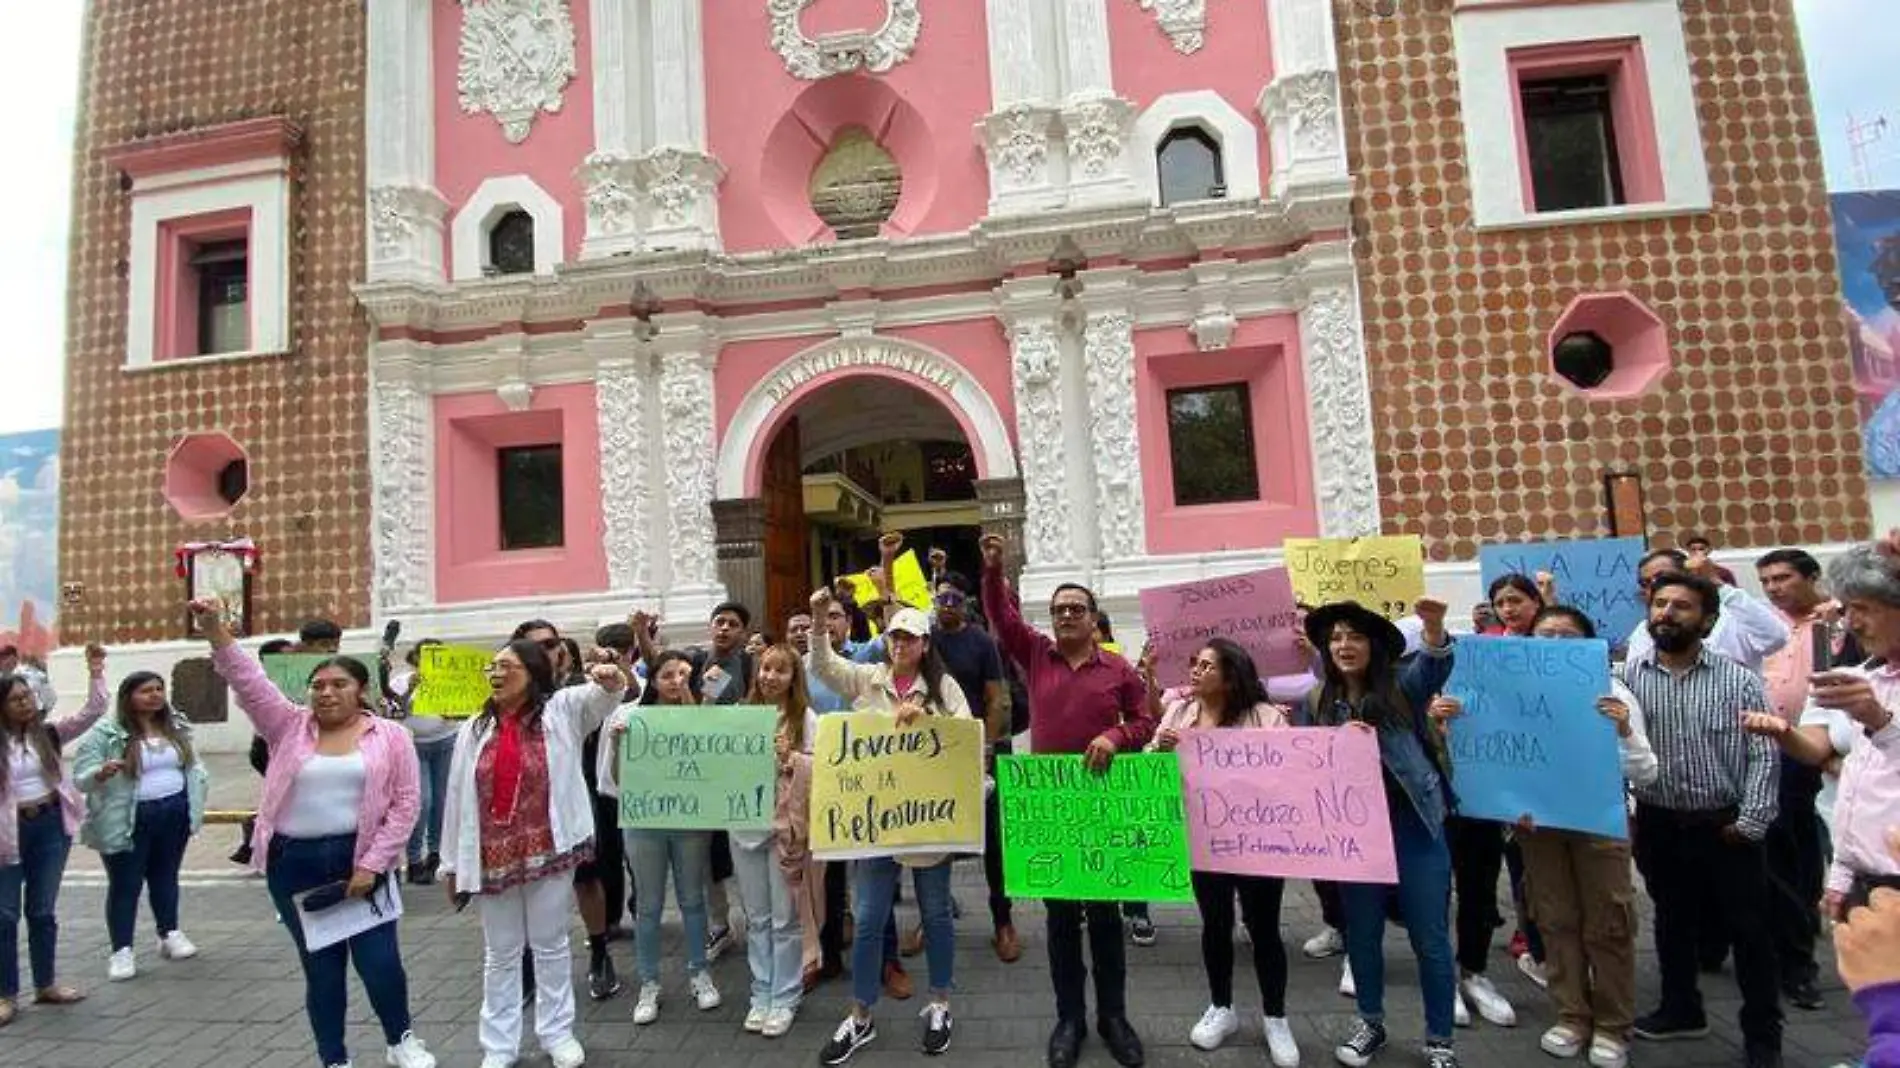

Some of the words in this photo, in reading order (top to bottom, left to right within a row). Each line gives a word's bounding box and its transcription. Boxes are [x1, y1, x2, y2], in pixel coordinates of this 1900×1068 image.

[1551, 553, 1572, 580] A
[1595, 552, 1631, 579] LA
[1355, 579, 1373, 592] la
[1517, 692, 1552, 719] LA
[626, 716, 767, 761] Democracia
[829, 720, 941, 765] Jovenes
[1196, 734, 1283, 769] Pueblo
[621, 789, 700, 823] Reforma
[827, 796, 956, 843] Reforma
[1197, 787, 1302, 829] Dedazo
[1314, 780, 1368, 826] NO
[1081, 850, 1105, 872] NO
